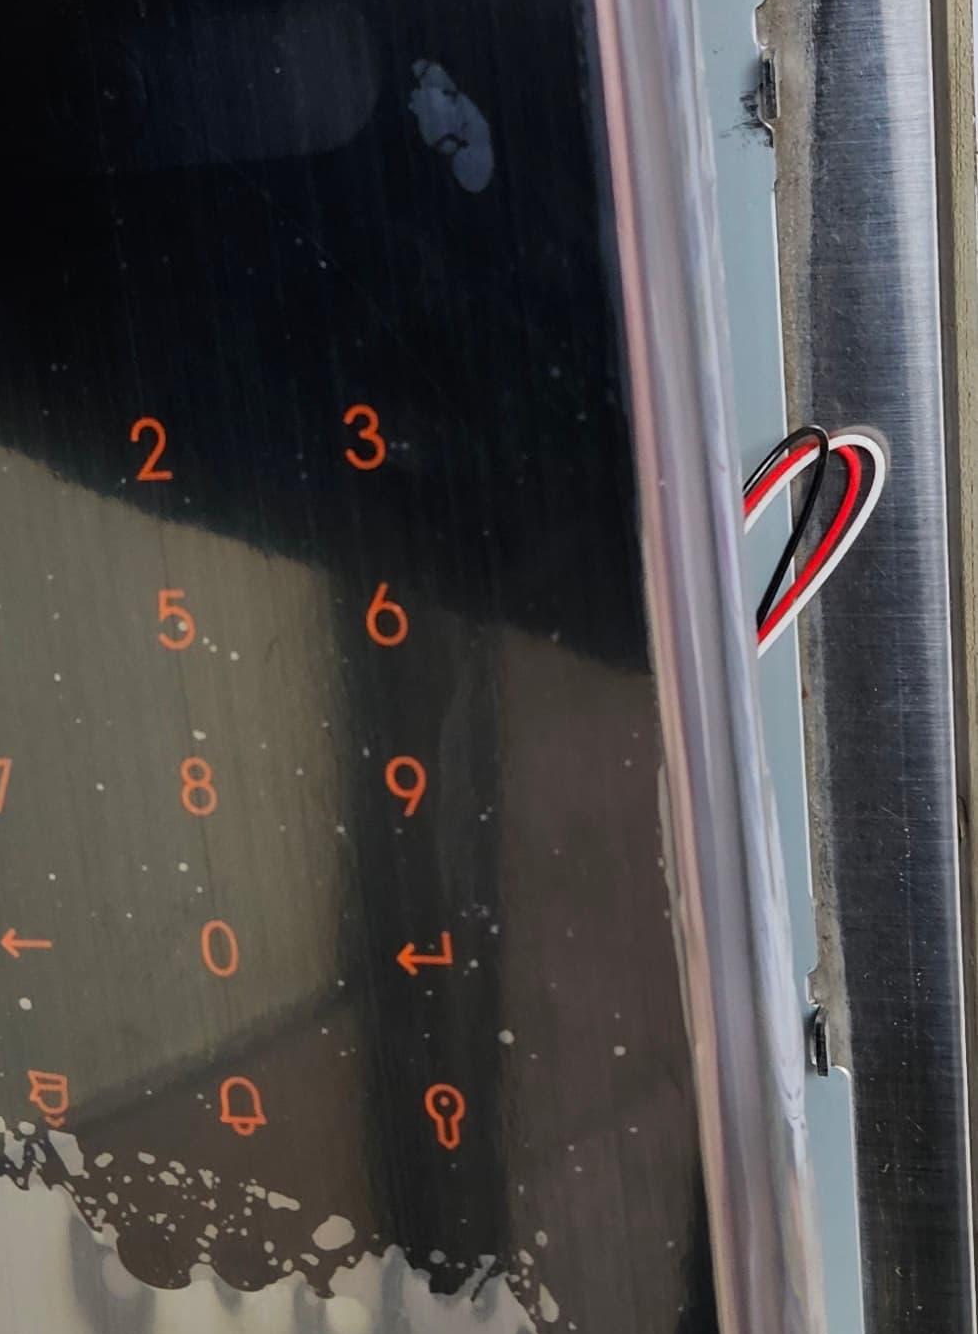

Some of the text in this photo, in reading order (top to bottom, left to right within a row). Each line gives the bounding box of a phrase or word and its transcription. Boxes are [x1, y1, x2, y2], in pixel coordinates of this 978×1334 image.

[131, 417, 172, 481] 2
[344, 404, 386, 469] 3
[157, 590, 195, 650] 5
[366, 583, 408, 646] 6
[181, 757, 217, 816] 8
[385, 756, 427, 816] 9
[201, 920, 239, 976] 0
